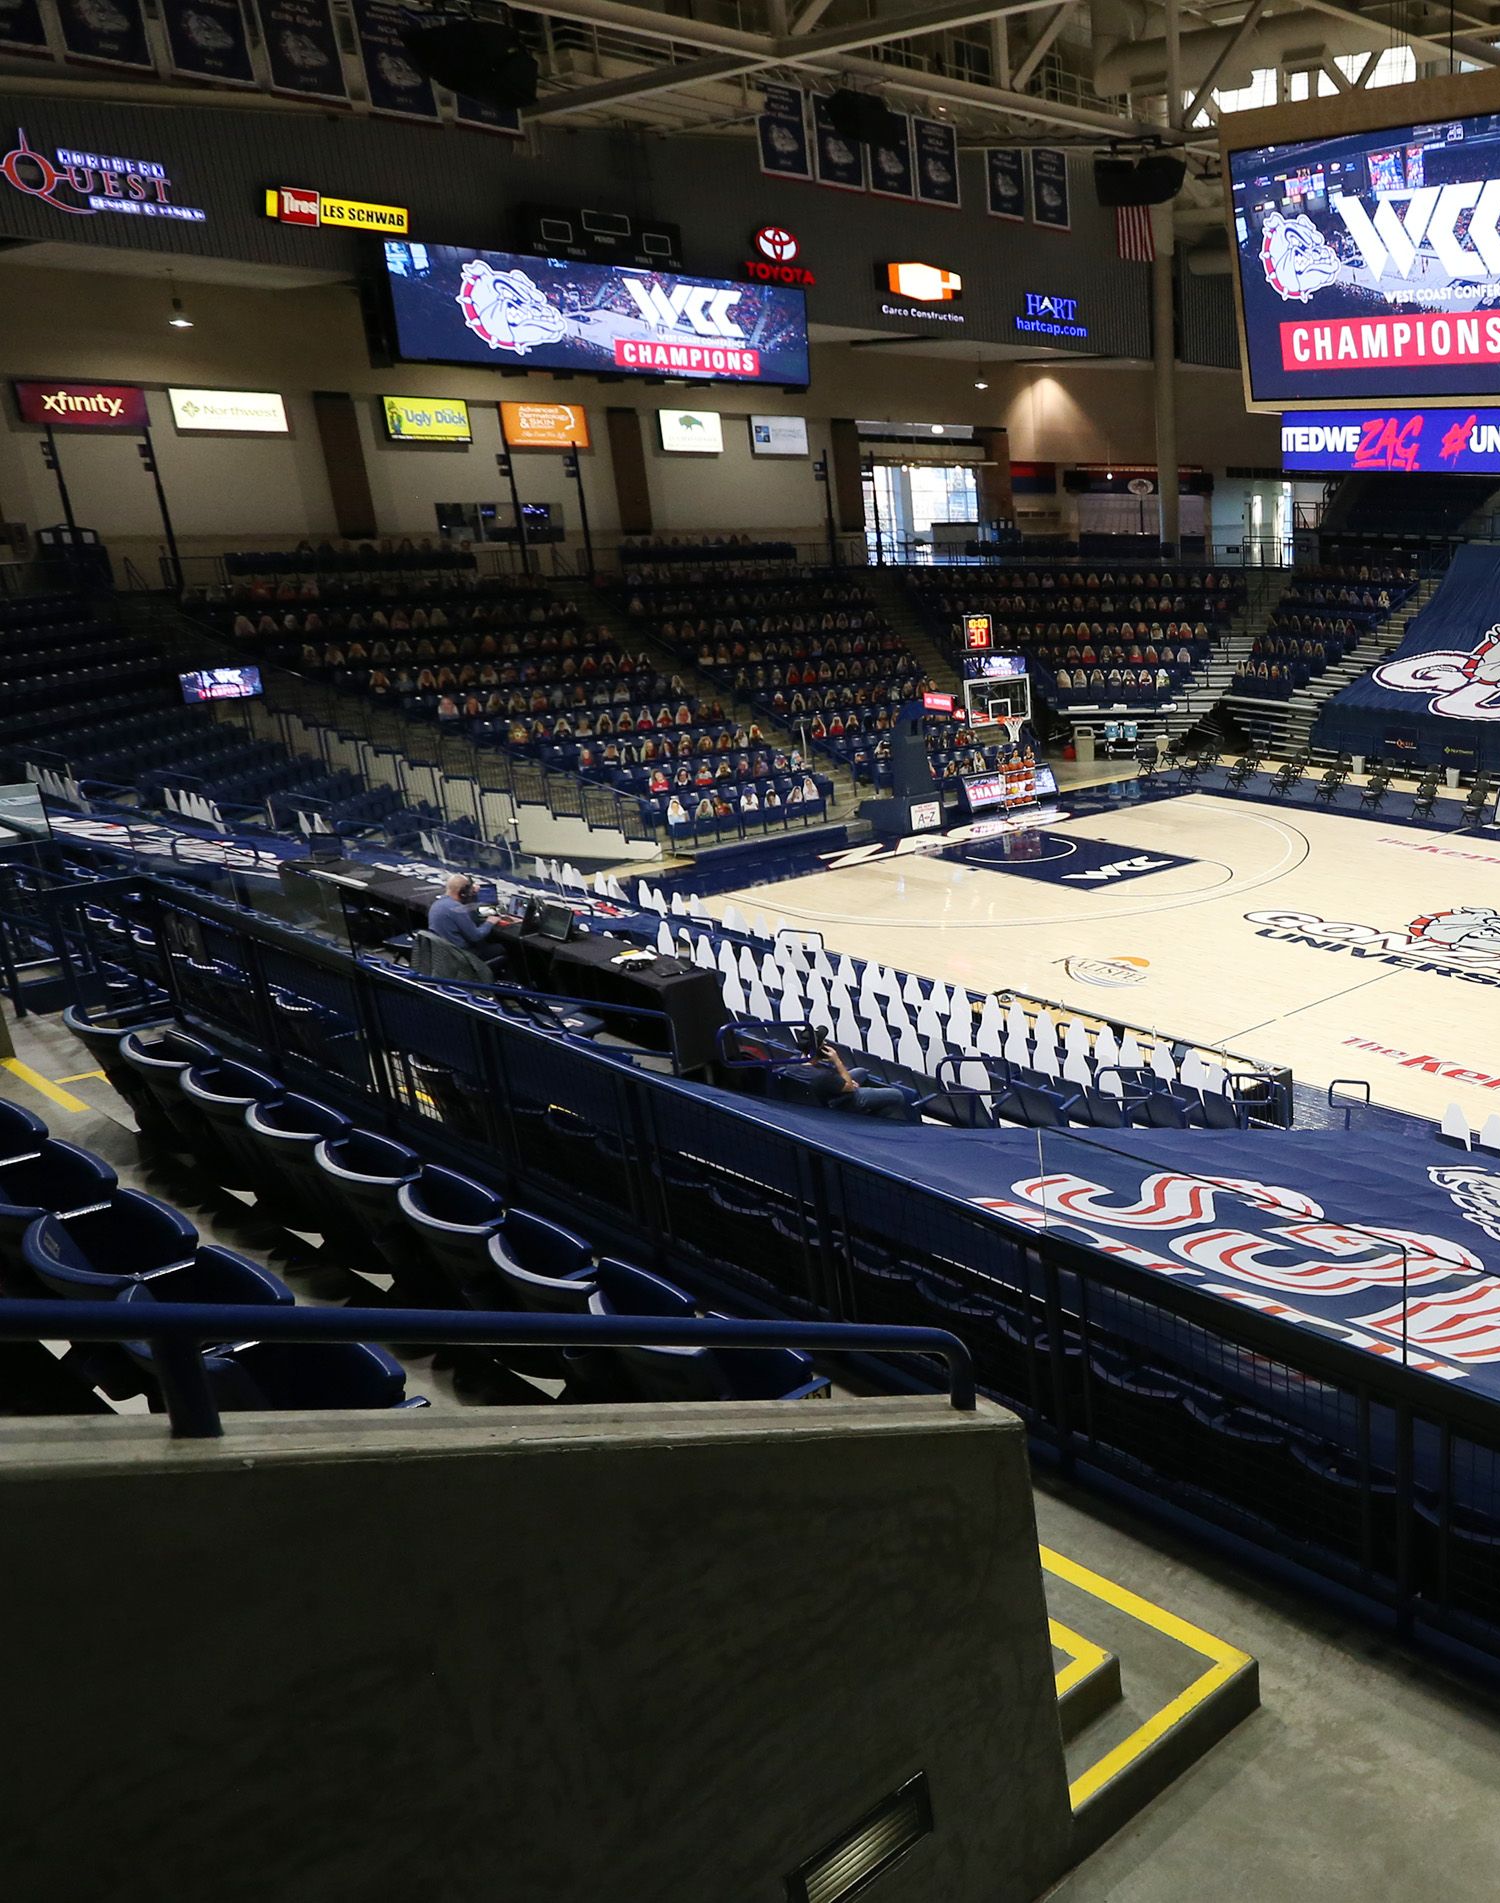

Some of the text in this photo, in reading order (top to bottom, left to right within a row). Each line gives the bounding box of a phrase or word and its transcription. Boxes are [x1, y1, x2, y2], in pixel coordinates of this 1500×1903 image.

[0, 127, 172, 215] QUEST
[56, 148, 166, 179] NORTHERN
[281, 190, 319, 215] Tires
[323, 203, 405, 226] LES SCHWAB
[745, 262, 816, 285] TOYOTA
[1025, 293, 1078, 321] HART
[1384, 288, 1415, 305] WEST
[1416, 285, 1453, 302] COAST
[621, 277, 746, 338] WCC
[881, 304, 965, 323] Garco Construction
[1016, 316, 1088, 338] hartcap.com
[623, 342, 755, 372] CHAMPIONS
[203, 404, 279, 419] Northwest
[404, 409, 467, 427] Ugly Duck
[969, 629, 987, 647] 30
[1060, 855, 1176, 881] WCC
[1341, 1034, 1410, 1062] The
